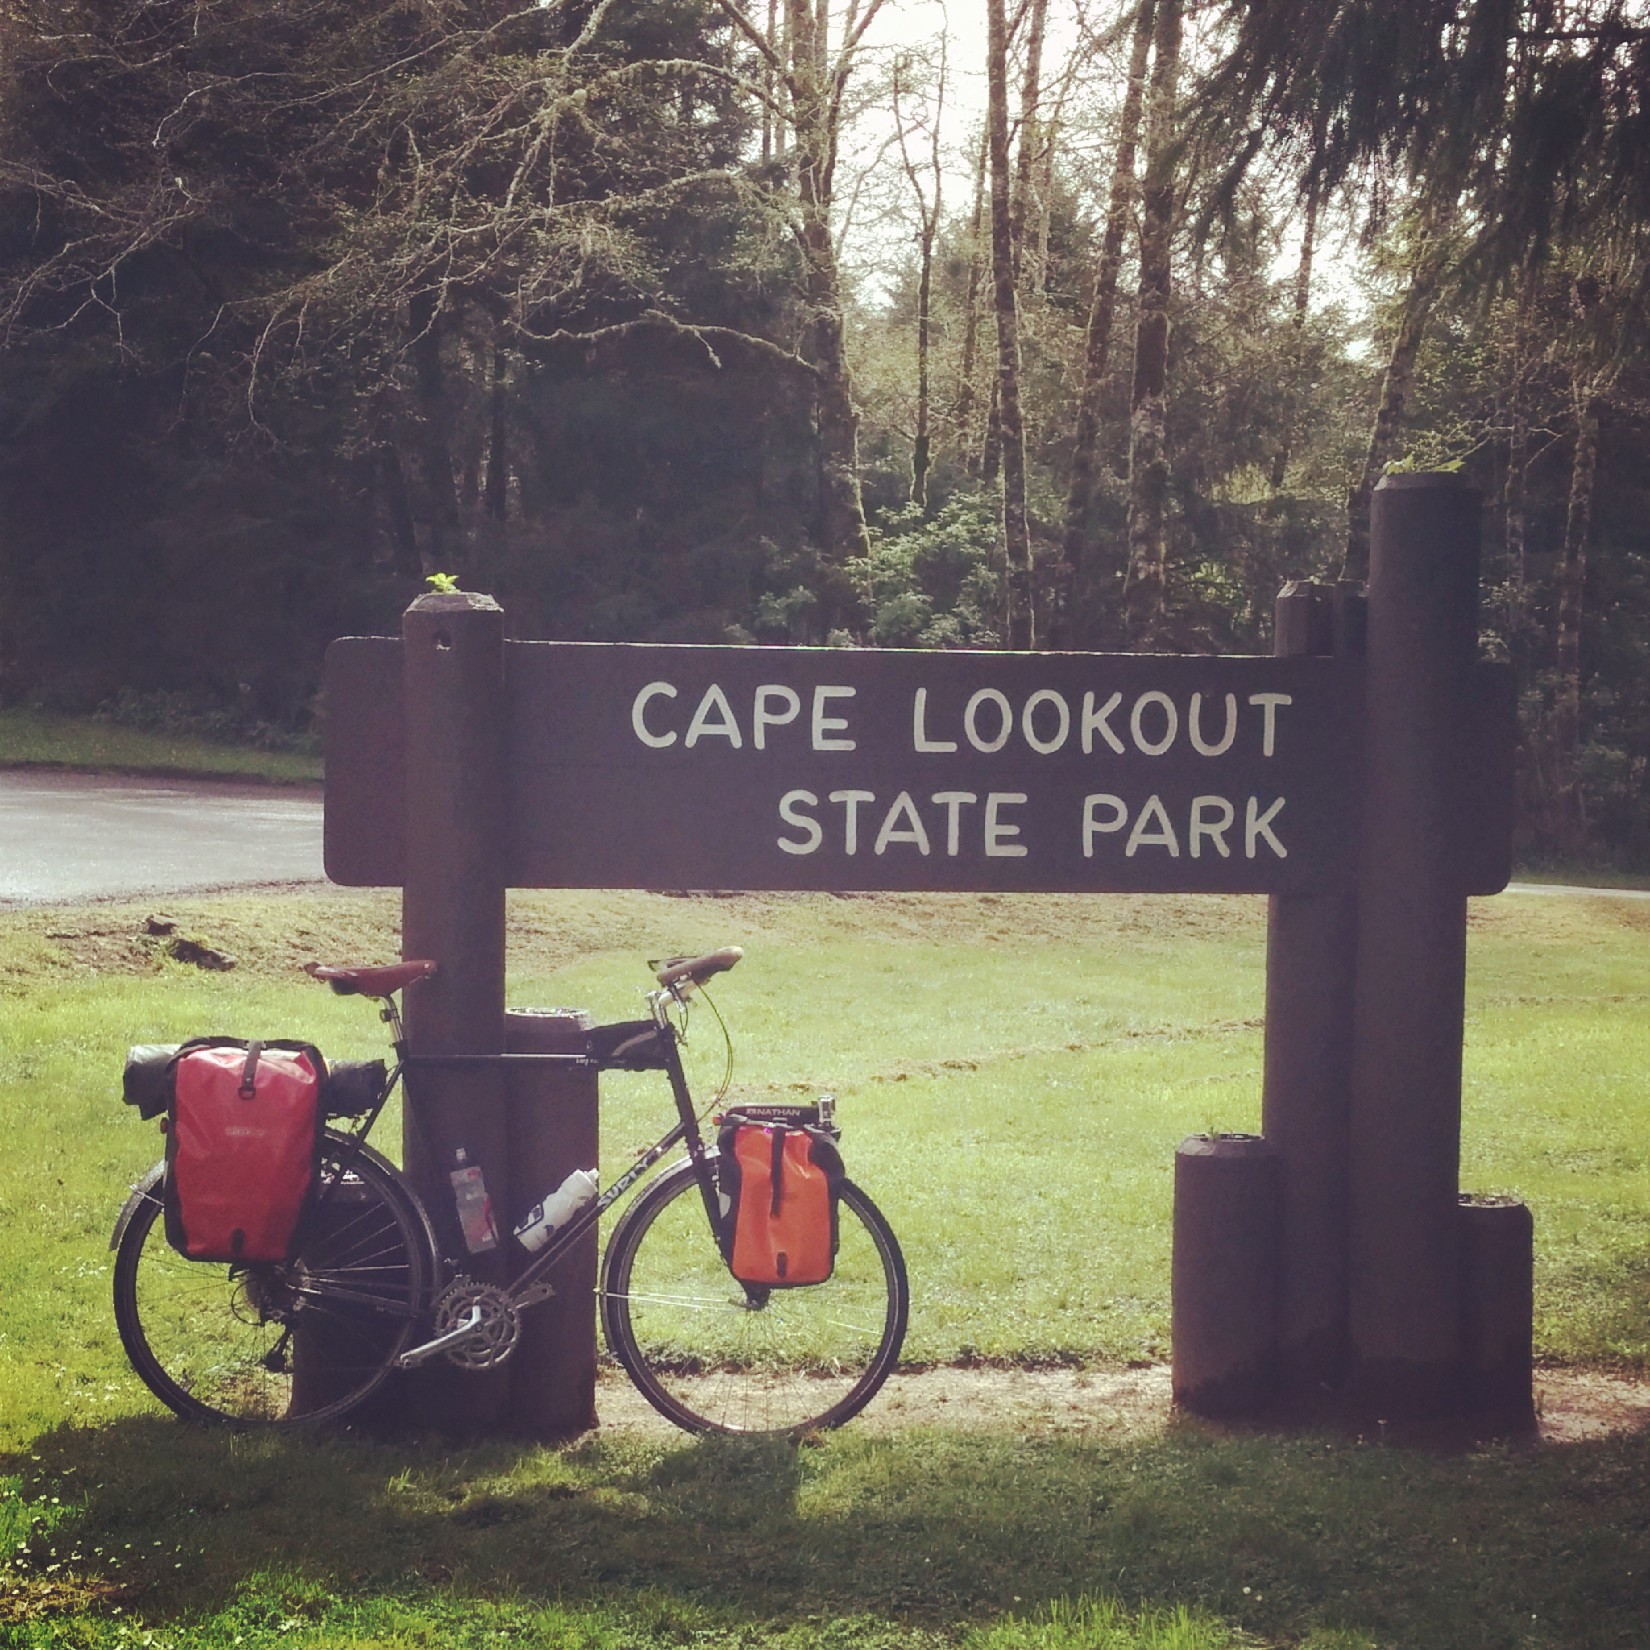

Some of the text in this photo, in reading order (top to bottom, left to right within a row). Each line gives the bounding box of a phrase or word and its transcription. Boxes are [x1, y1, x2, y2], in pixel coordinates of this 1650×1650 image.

[631, 681, 1292, 757] CAPE LOOKOUT
[776, 789, 1288, 859] STATE PARK
[756, 1108, 801, 1116] NATHAN
